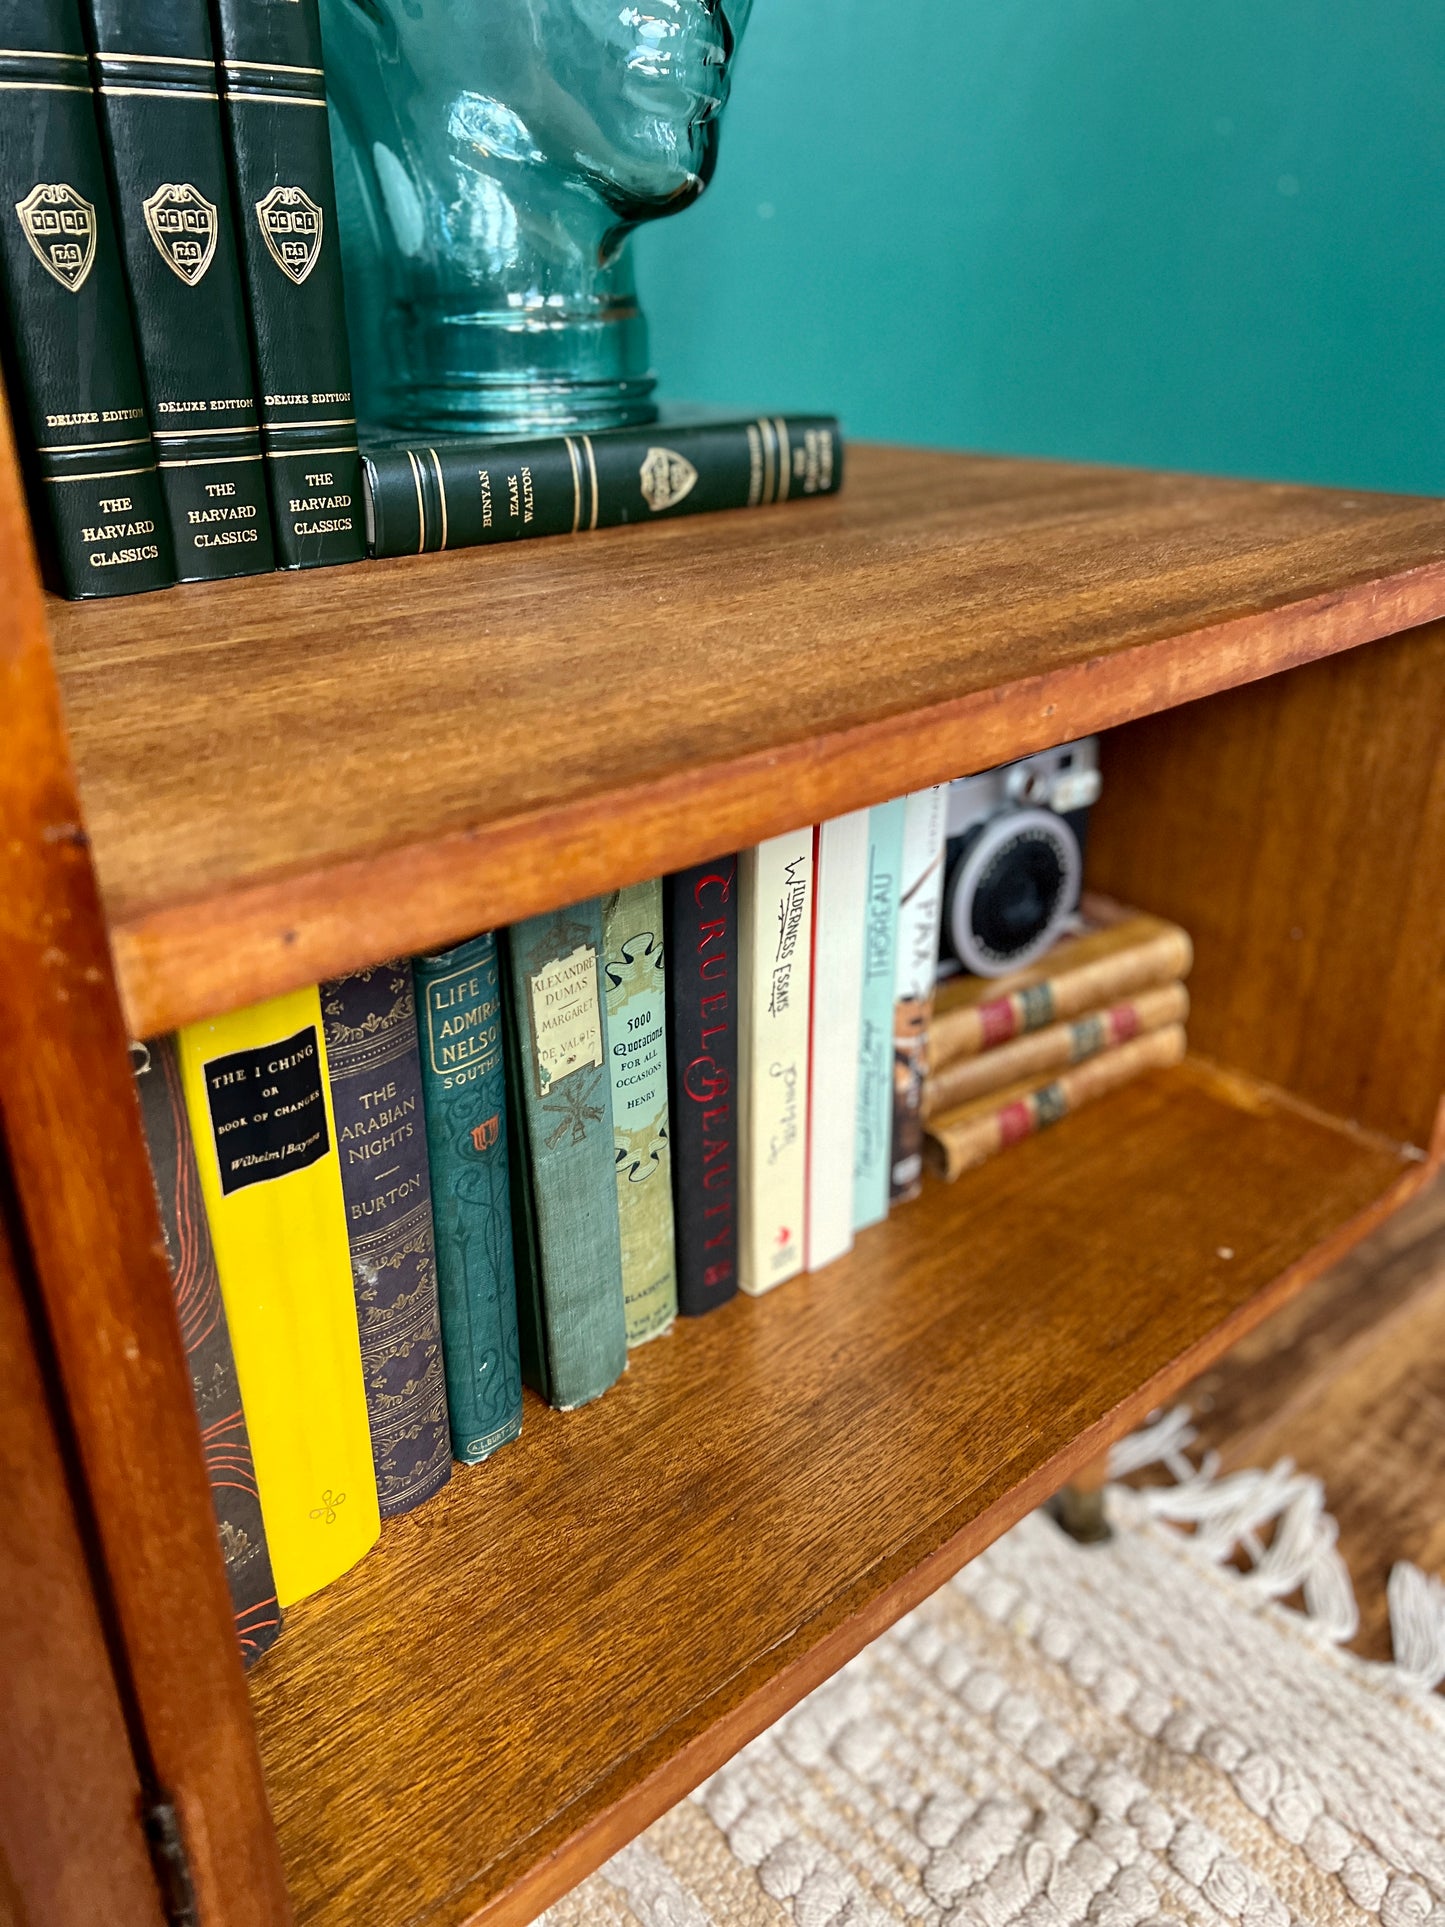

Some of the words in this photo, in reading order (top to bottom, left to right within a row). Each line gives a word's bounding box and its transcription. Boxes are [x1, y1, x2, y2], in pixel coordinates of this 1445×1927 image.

[158, 401, 207, 413] DELUXE
[209, 399, 253, 410] EDITION
[264, 394, 310, 405] DELUXE
[311, 392, 351, 403] EDITION
[46, 412, 99, 427] DELUXE
[102, 407, 144, 422] EDITION
[205, 482, 236, 497] THE
[305, 473, 333, 487] THE
[99, 497, 133, 513] THE
[289, 495, 352, 512] HARVARD
[478, 470, 492, 528] BUNYAN
[507, 474, 519, 517] IZAAK
[521, 466, 533, 523] WALTON
[187, 505, 256, 524] HARVARD
[293, 518, 352, 536] CLASSICS
[81, 520, 155, 542] HARVARD
[193, 529, 258, 548] CLASSICS
[89, 545, 159, 567] CLASSICS
[693, 866, 731, 1050] CRUEL
[533, 956, 595, 994] ALEXANDRE
[435, 978, 480, 1009] LIFE
[545, 976, 589, 1006] DUMAS
[541, 998, 594, 1033] MARGARET
[627, 1010, 652, 1034] 5000
[442, 1022, 499, 1065] NELSO
[542, 1050, 556, 1062] DE
[560, 1029, 597, 1057] VALOIS
[613, 1026, 663, 1057] Quotations
[212, 1069, 247, 1089] THE
[255, 1066, 261, 1078] I
[267, 1044, 314, 1074] CHING
[621, 1058, 641, 1072] FOR
[643, 1049, 658, 1062] ALL
[616, 1062, 662, 1088] OCCASIONS
[262, 1086, 279, 1098] OR
[359, 1082, 397, 1109] THE
[627, 1090, 656, 1109] HENRY
[218, 1117, 248, 1135] BOOK
[253, 1112, 269, 1123] OF
[274, 1089, 320, 1118] CHANGES
[340, 1096, 415, 1142] ARABIAN
[348, 1122, 414, 1164] NIGHTS
[683, 1056, 732, 1249] BEAUTY
[350, 1173, 421, 1220] BURTON
